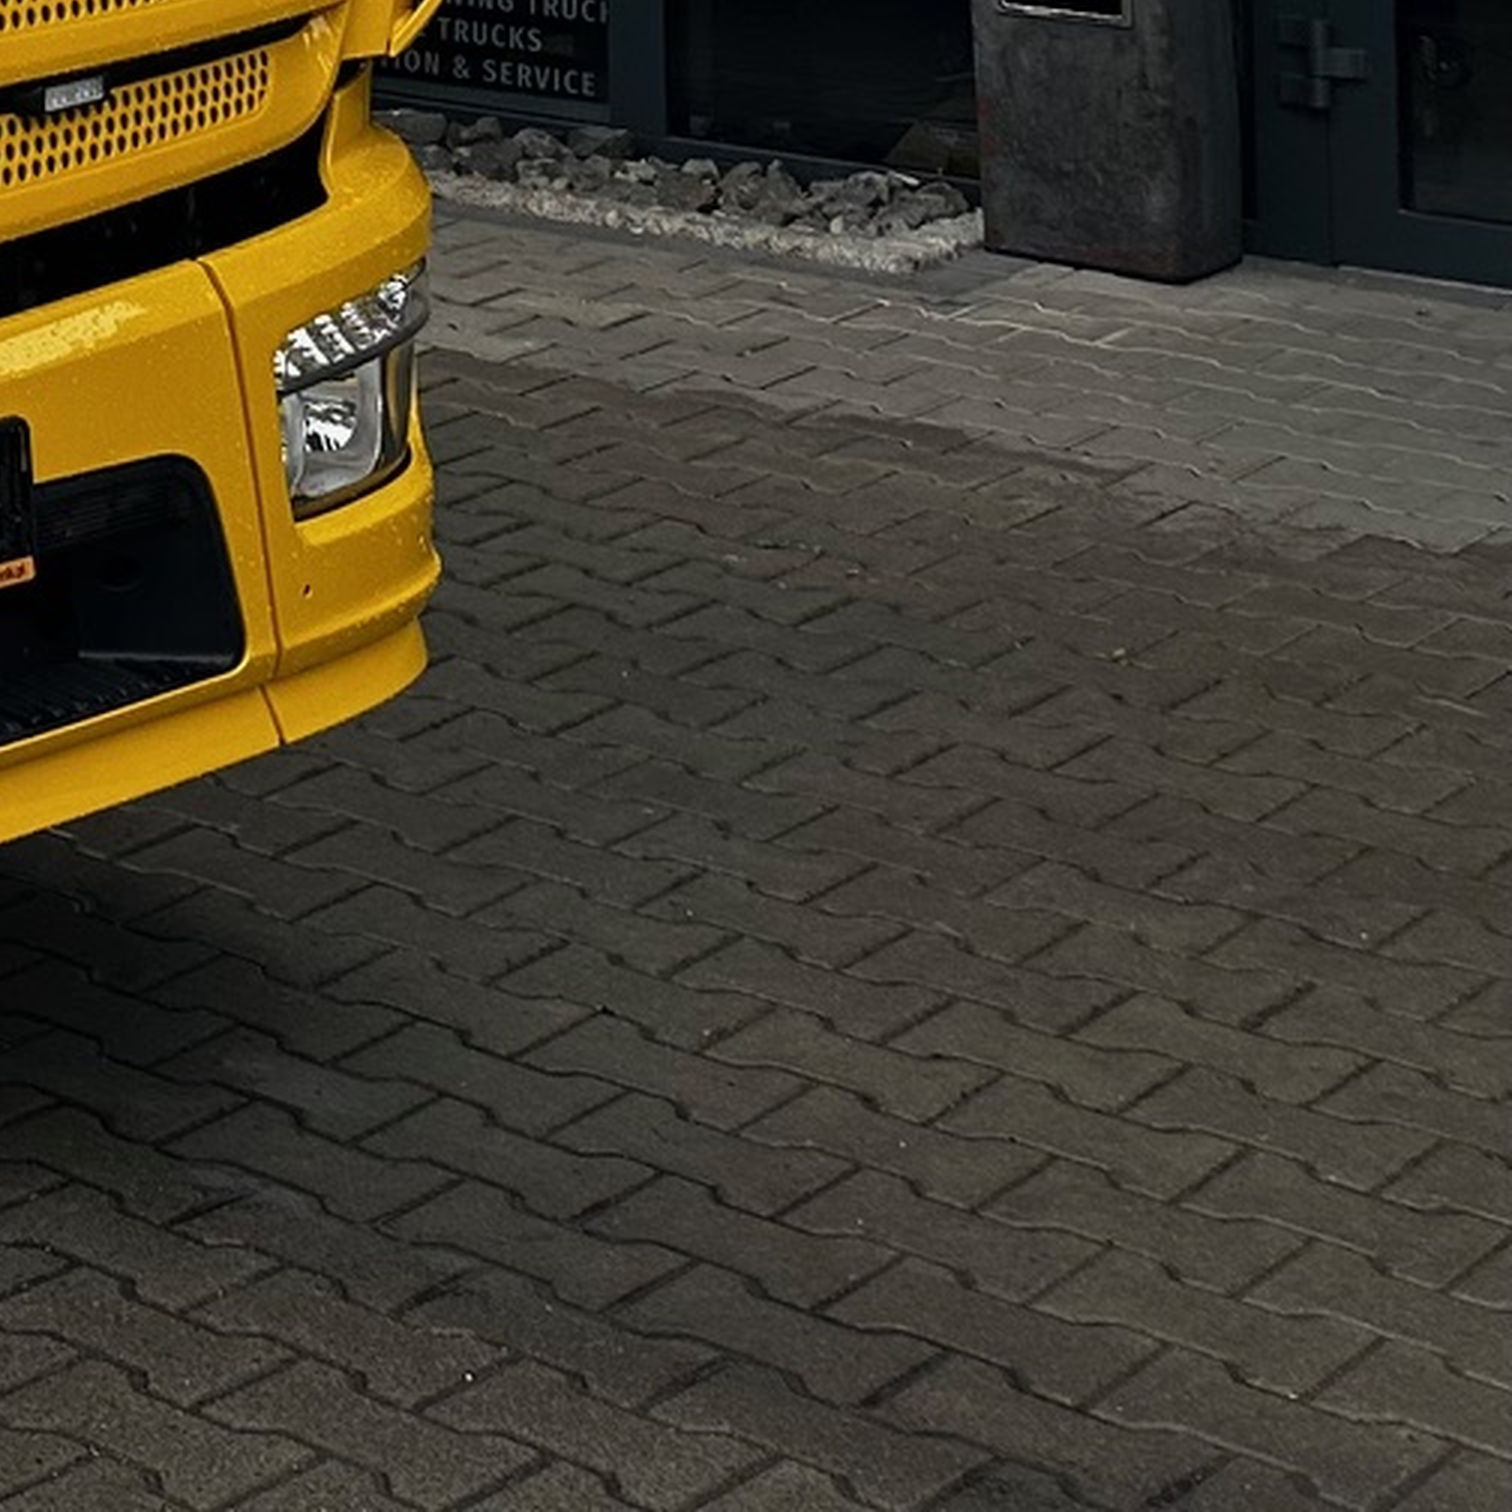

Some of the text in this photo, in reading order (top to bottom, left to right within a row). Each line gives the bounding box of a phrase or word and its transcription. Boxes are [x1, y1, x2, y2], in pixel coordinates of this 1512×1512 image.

[436, 16, 543, 53] TRUCKS
[452, 54, 472, 80] &
[481, 58, 597, 97] SERVICE
